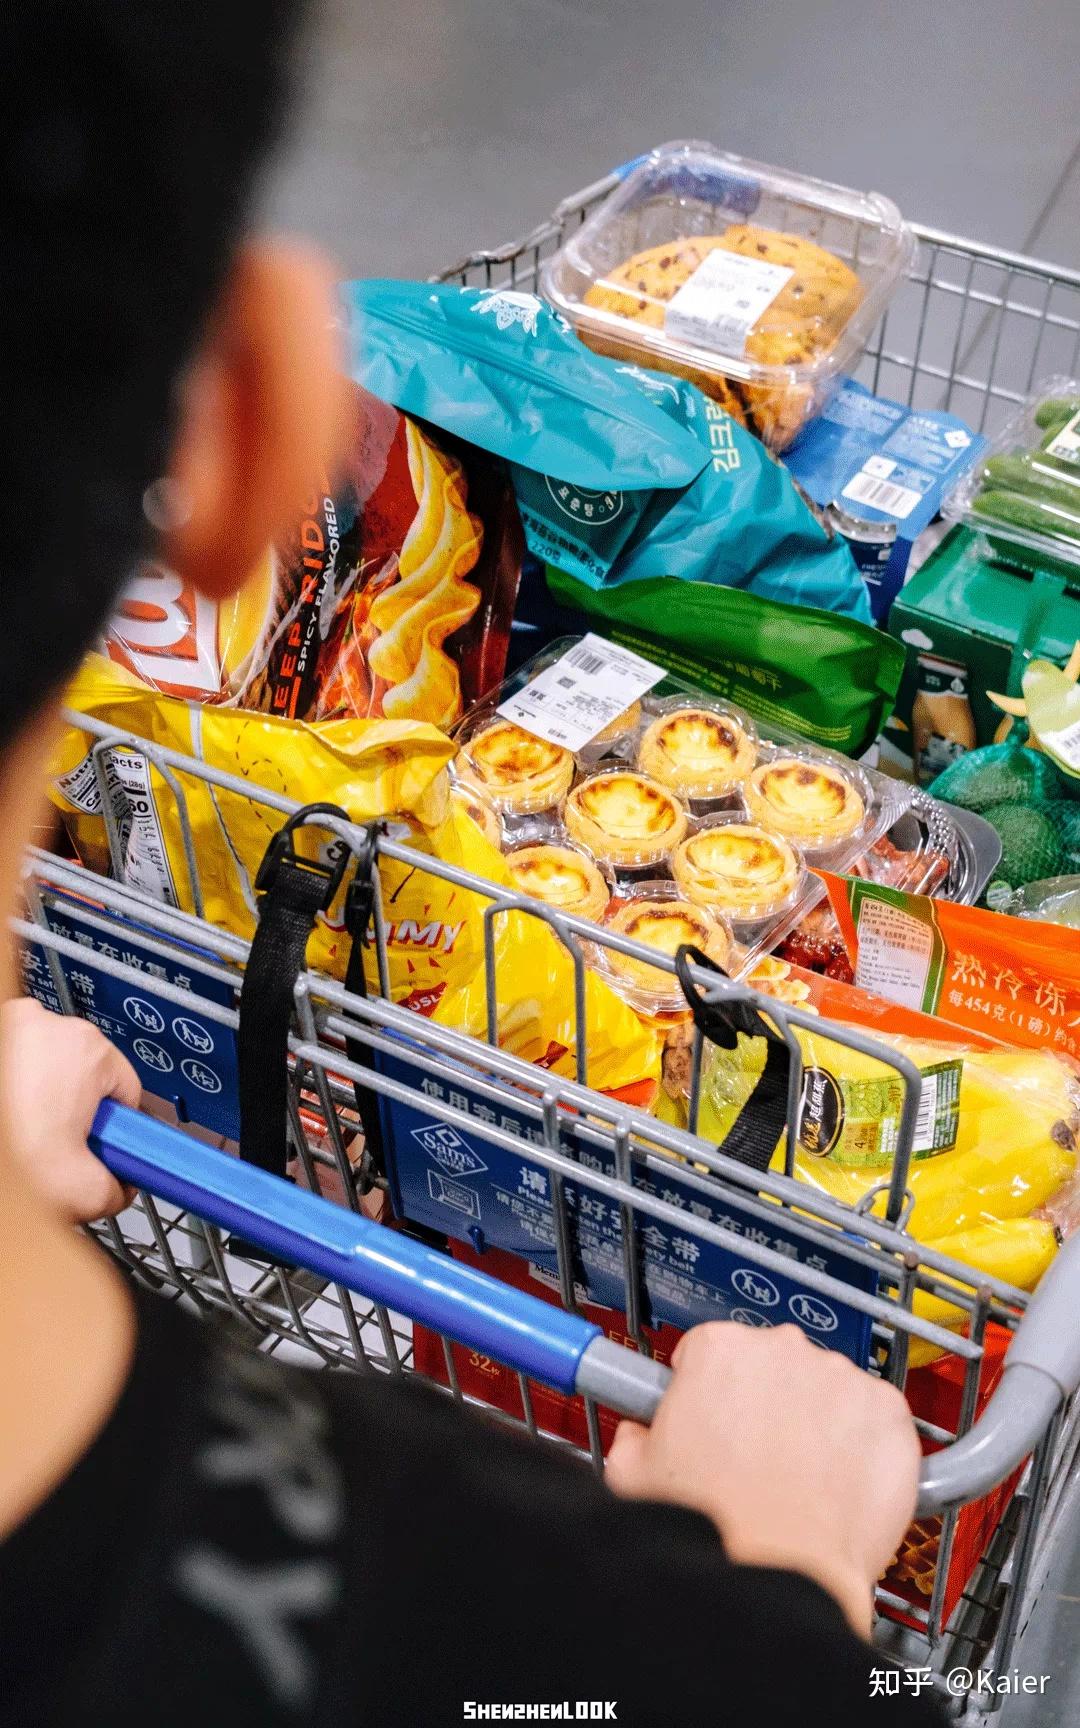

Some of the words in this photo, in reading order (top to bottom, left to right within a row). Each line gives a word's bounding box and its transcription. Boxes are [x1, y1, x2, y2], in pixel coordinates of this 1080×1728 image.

[297, 612, 318, 673] SPICY
[315, 497, 340, 607] FLAVORED
[273, 622, 301, 709] EEP
[112, 755, 143, 770] acts
[669, 1253, 694, 1274] belt
